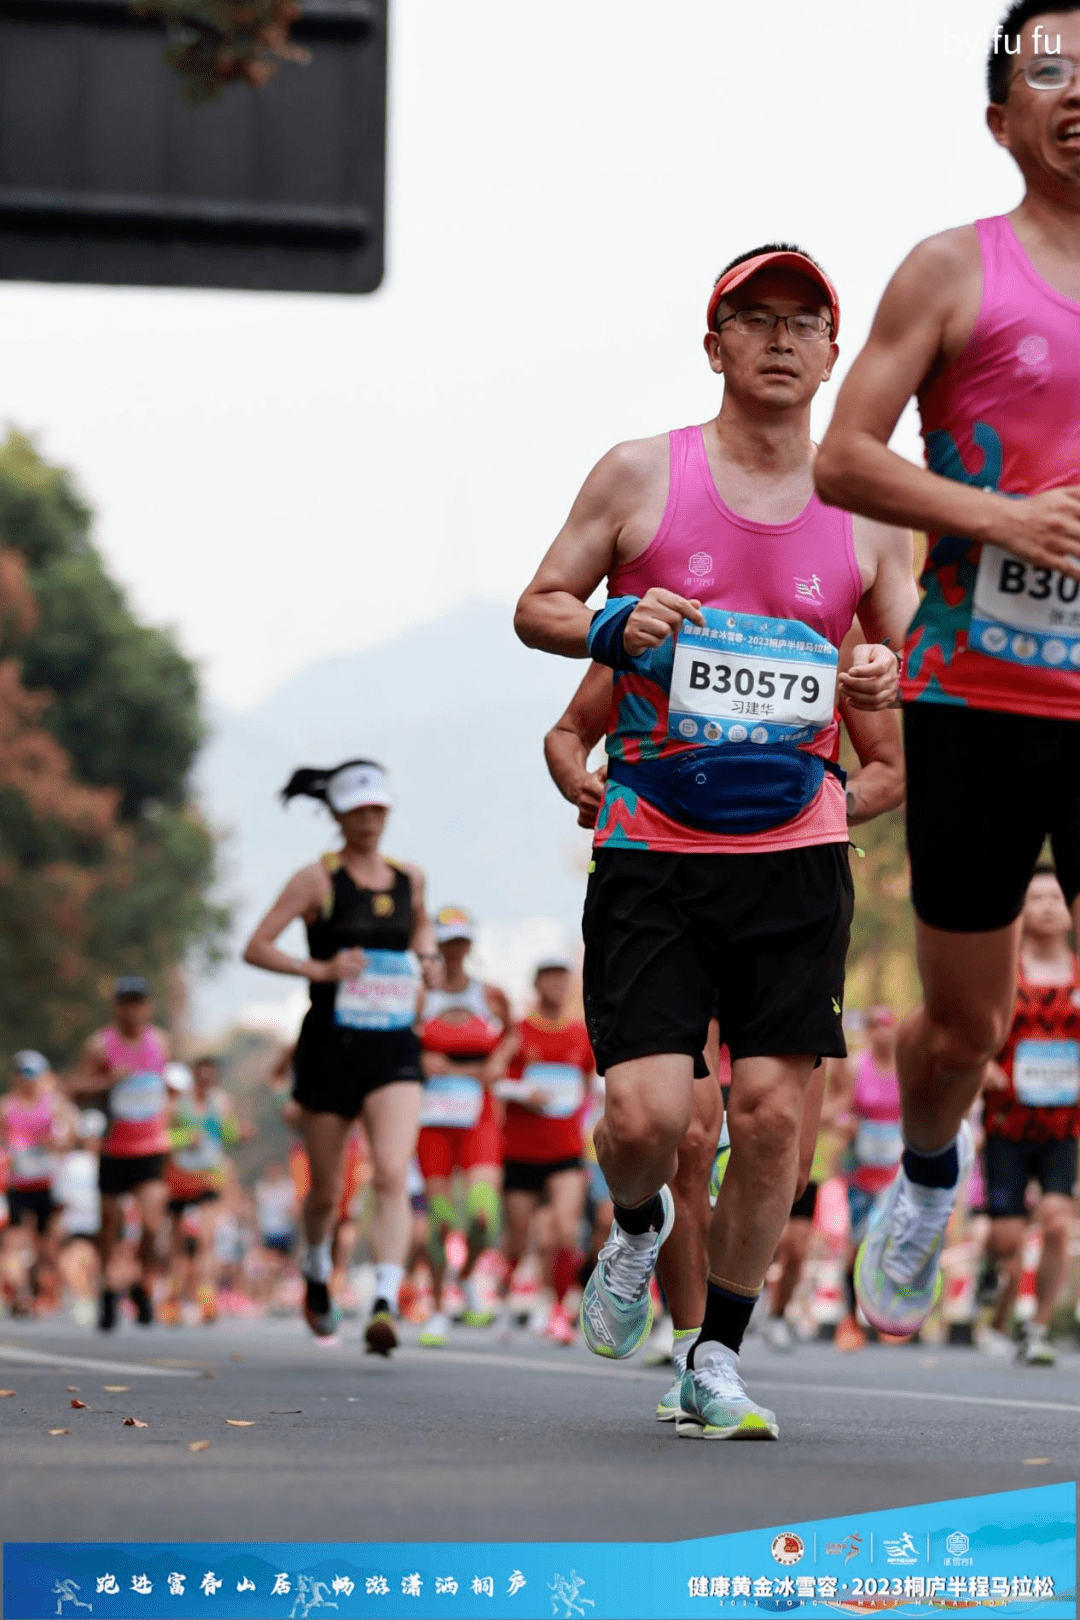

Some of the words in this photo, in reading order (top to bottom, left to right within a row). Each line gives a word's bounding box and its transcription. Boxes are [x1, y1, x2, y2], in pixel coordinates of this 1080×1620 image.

[689, 660, 820, 704] B30579
[731, 700, 775, 716] 习建华
